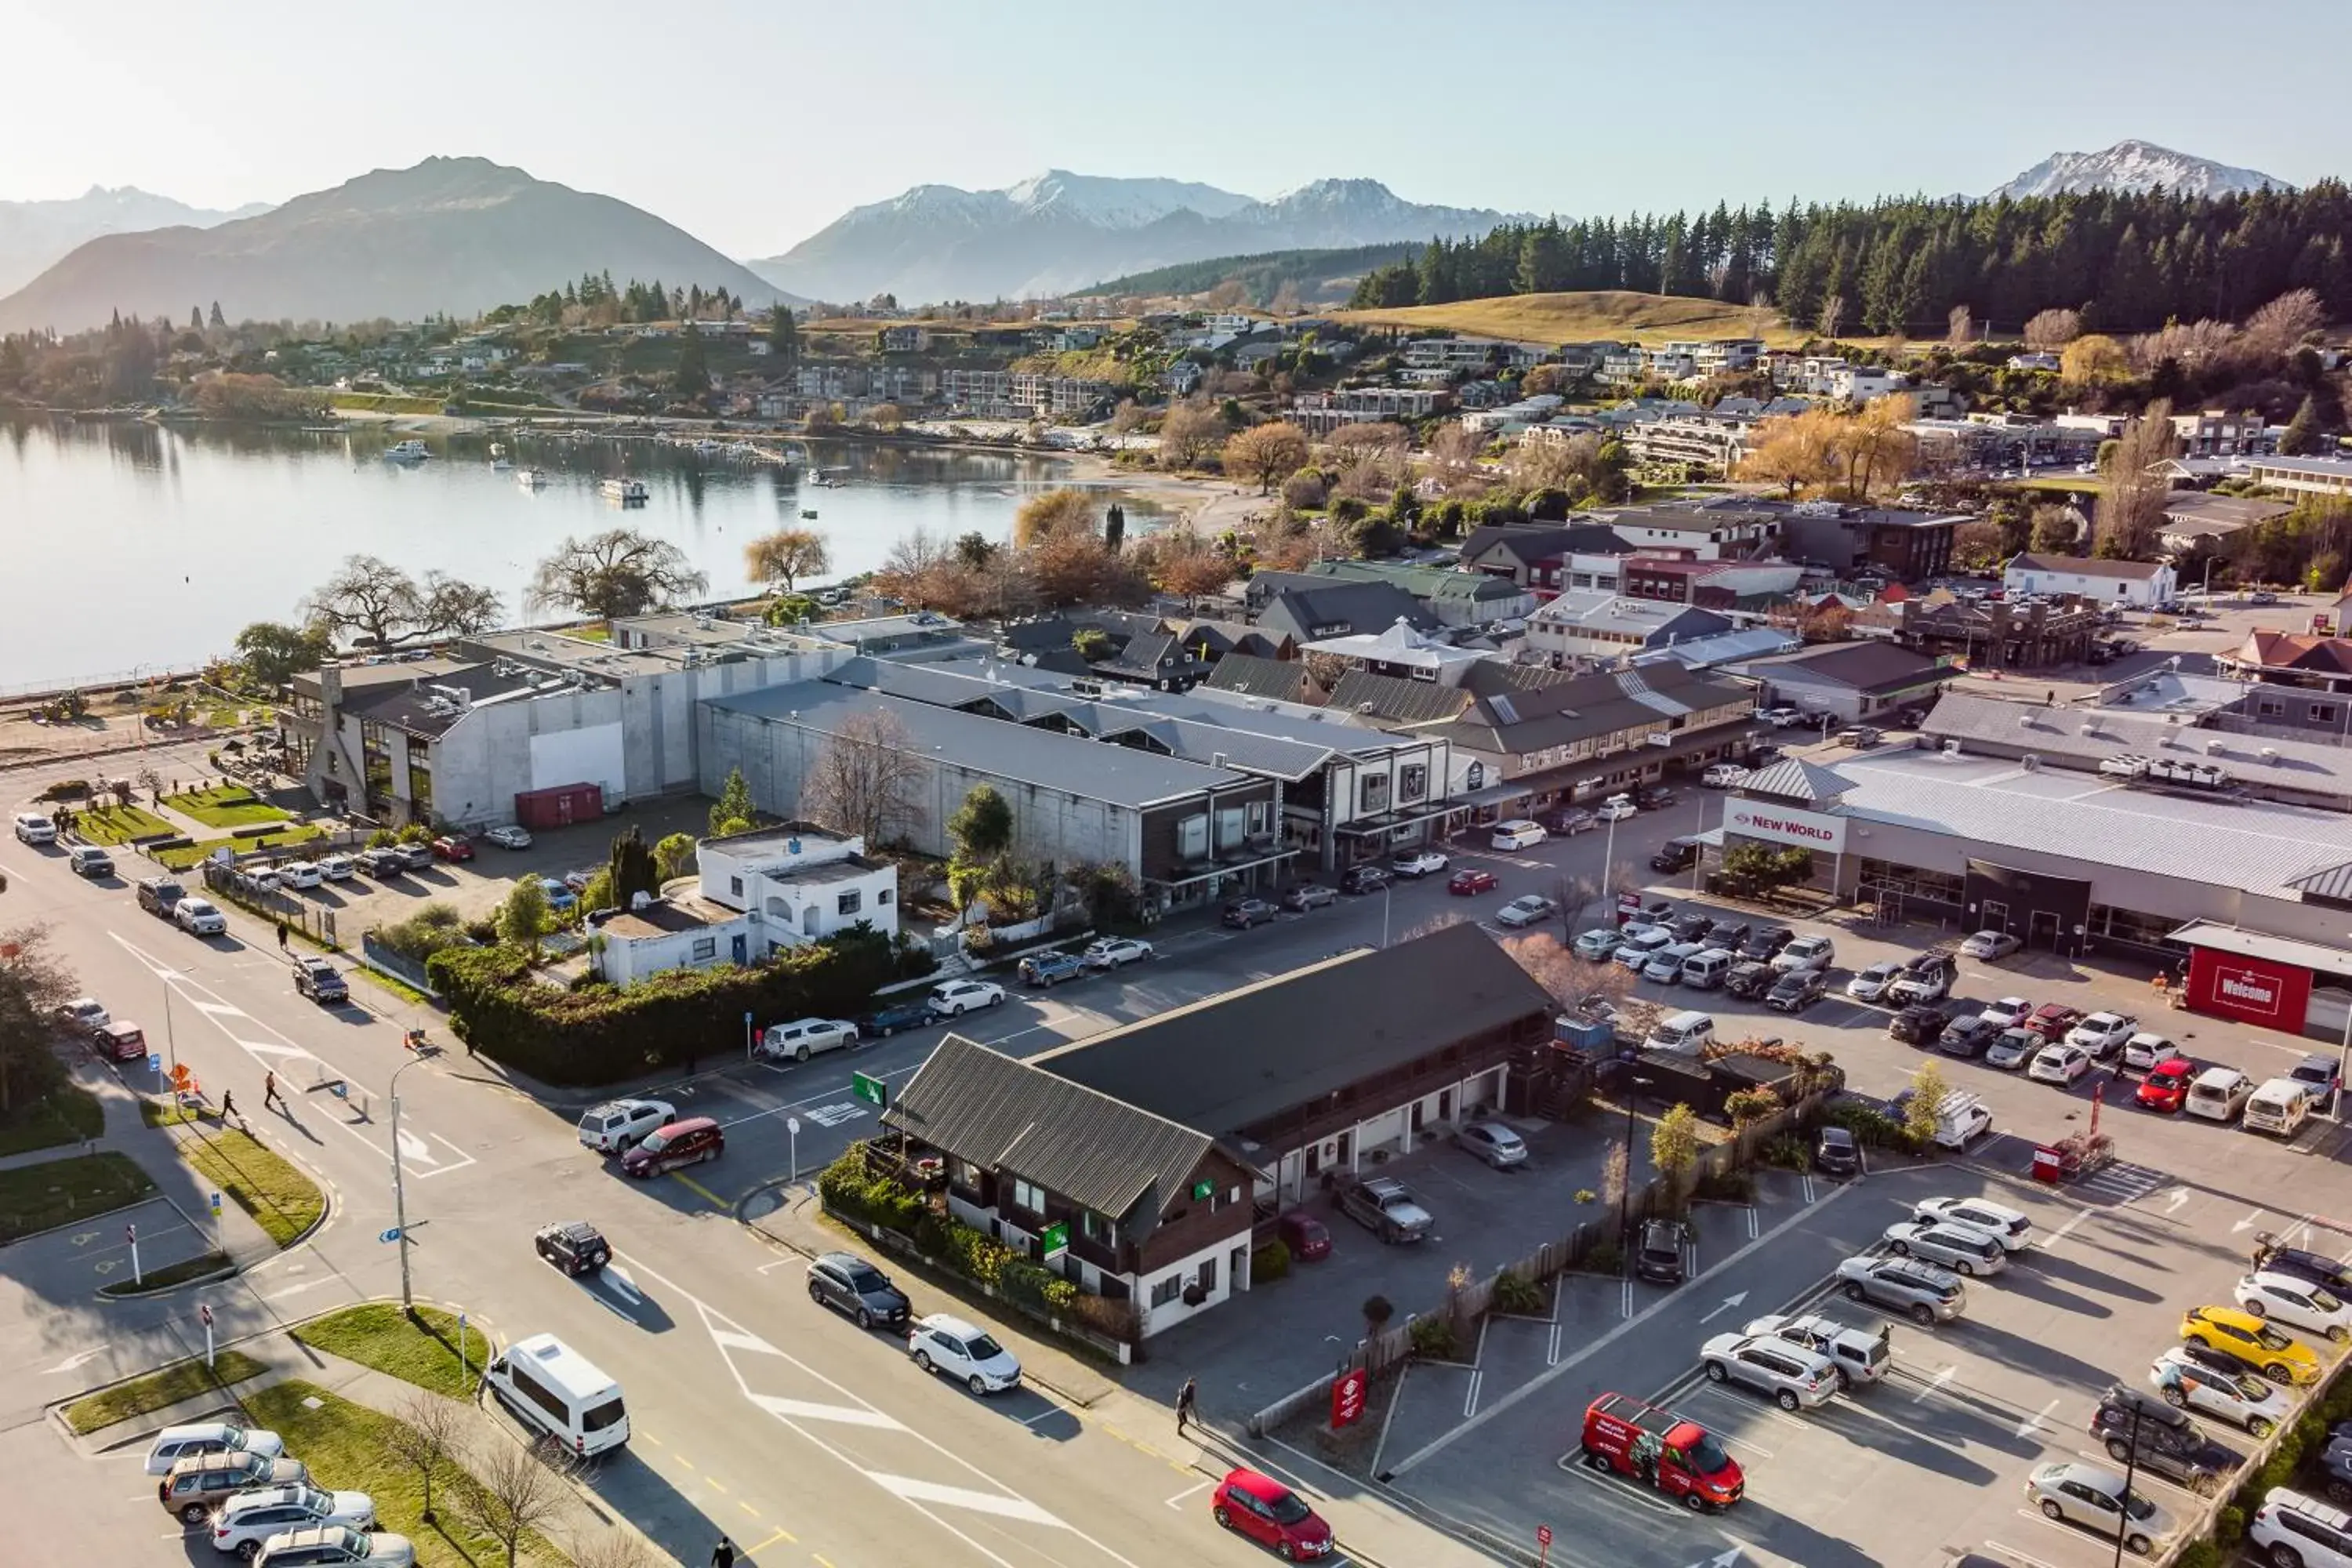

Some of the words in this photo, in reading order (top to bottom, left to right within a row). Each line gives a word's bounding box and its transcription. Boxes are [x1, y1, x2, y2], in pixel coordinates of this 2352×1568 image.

[1752, 815, 1782, 831] NEW
[1785, 821, 1833, 841] WORLD
[2223, 978, 2271, 1003] Welcome
